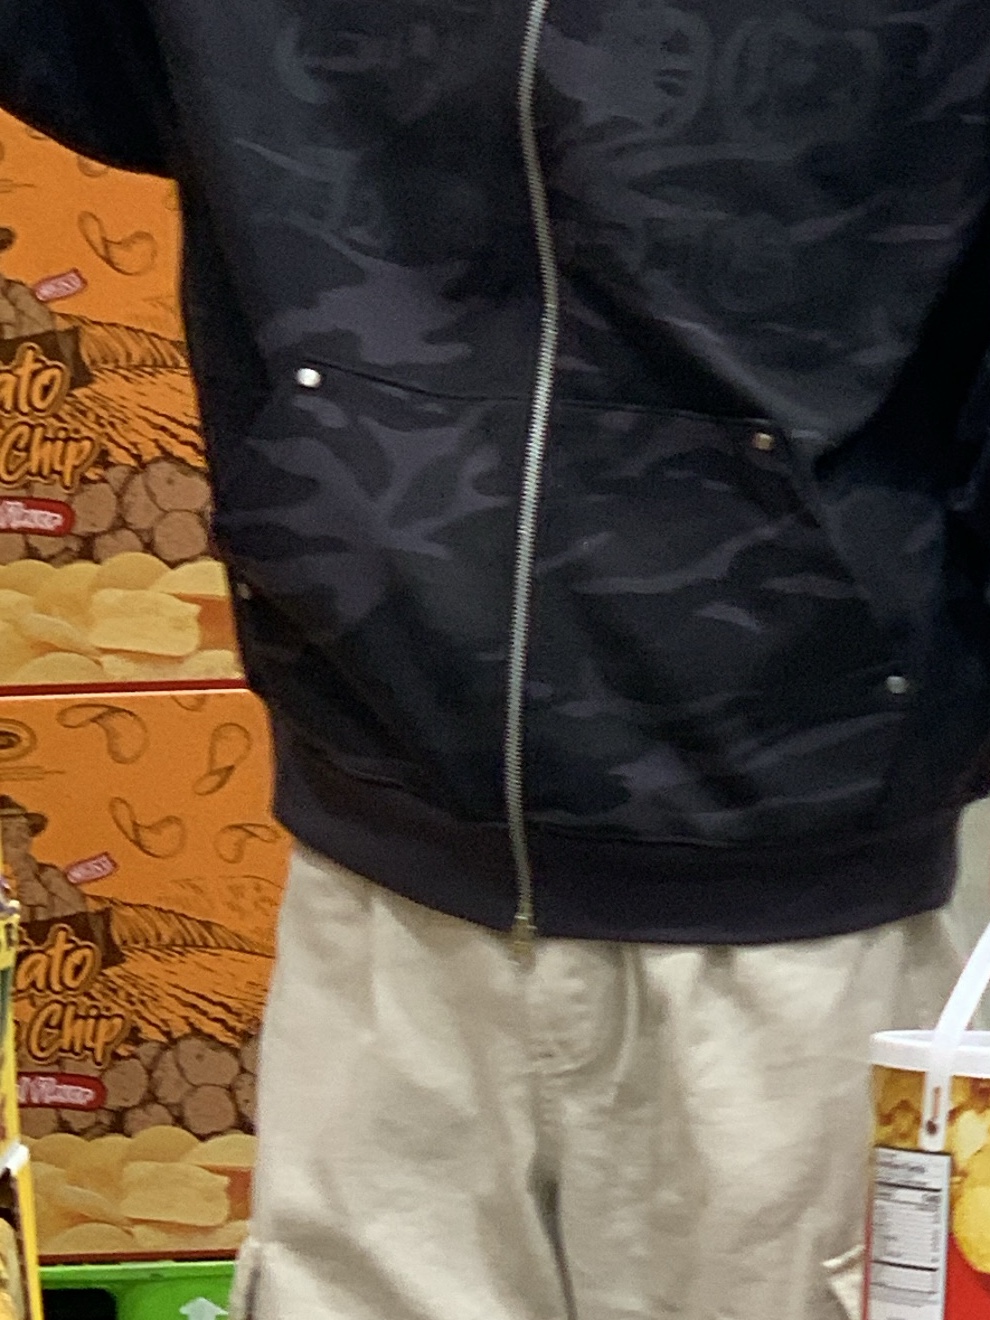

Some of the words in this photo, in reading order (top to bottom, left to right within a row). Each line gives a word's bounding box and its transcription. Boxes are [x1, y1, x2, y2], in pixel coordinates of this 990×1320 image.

[0, 348, 63, 416] ato
[15, 920, 95, 994] ato
[29, 1002, 124, 1066] Chip
